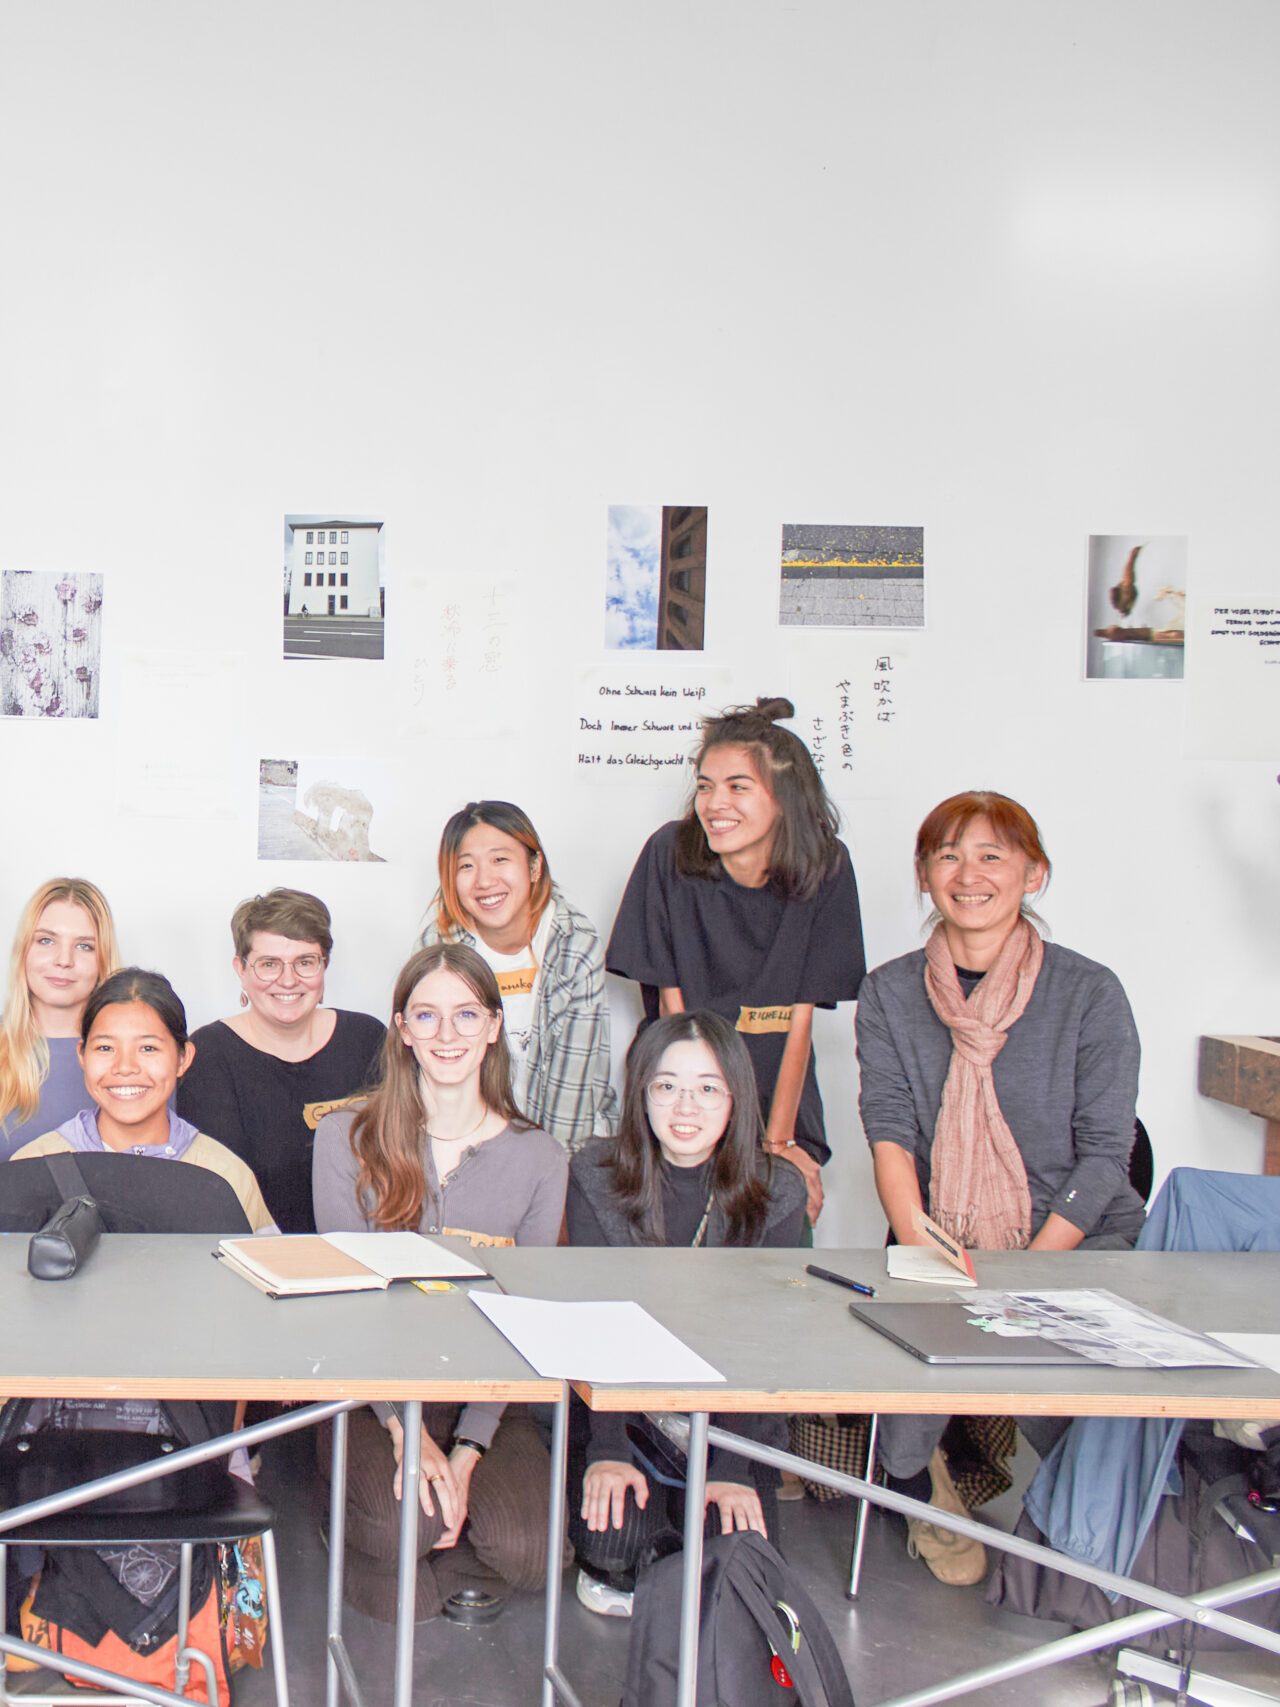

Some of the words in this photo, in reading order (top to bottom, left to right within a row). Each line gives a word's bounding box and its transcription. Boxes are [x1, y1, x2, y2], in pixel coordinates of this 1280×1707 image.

[599, 686, 621, 696] Ohne
[660, 685, 677, 697] kein
[873, 656, 896, 722] 風吹かば
[580, 717, 602, 731] Doch
[678, 721, 693, 731] und
[835, 679, 854, 771] やまぶき色の
[606, 754, 624, 765] das
